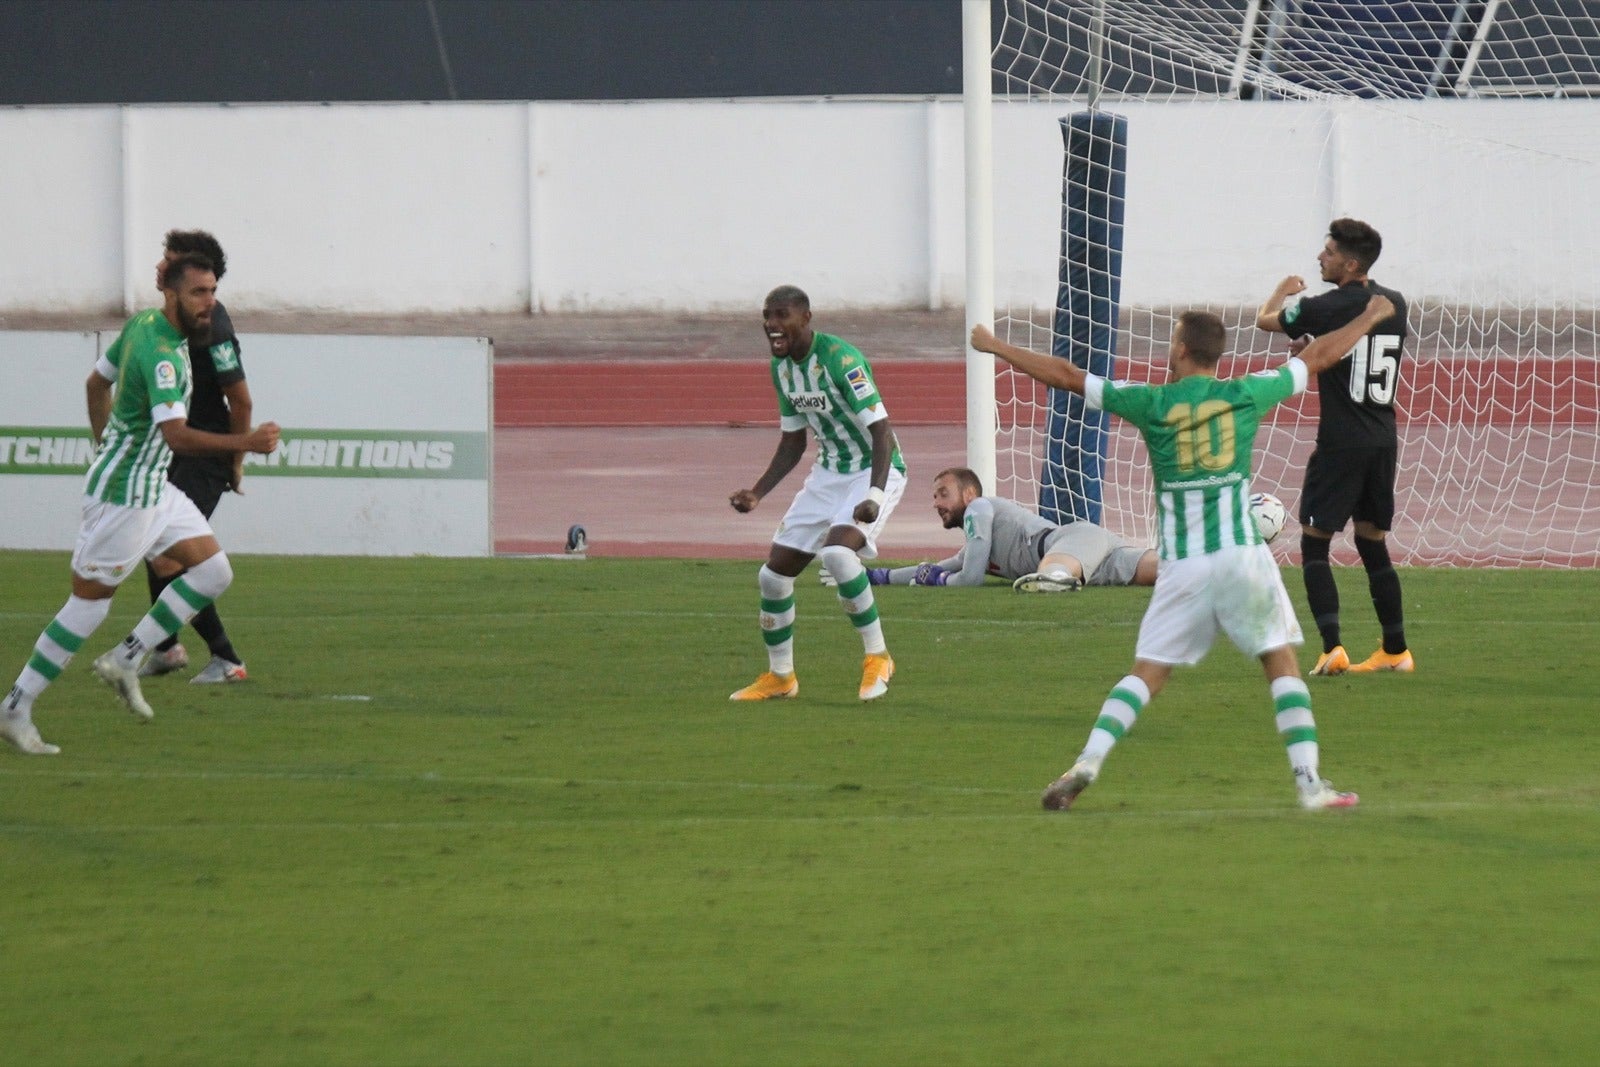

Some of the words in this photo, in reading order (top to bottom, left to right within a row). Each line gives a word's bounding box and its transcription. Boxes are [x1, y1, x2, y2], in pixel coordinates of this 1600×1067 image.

[787, 394, 827, 411] betway
[1342, 334, 1401, 405] 15
[1165, 399, 1236, 473] 10
